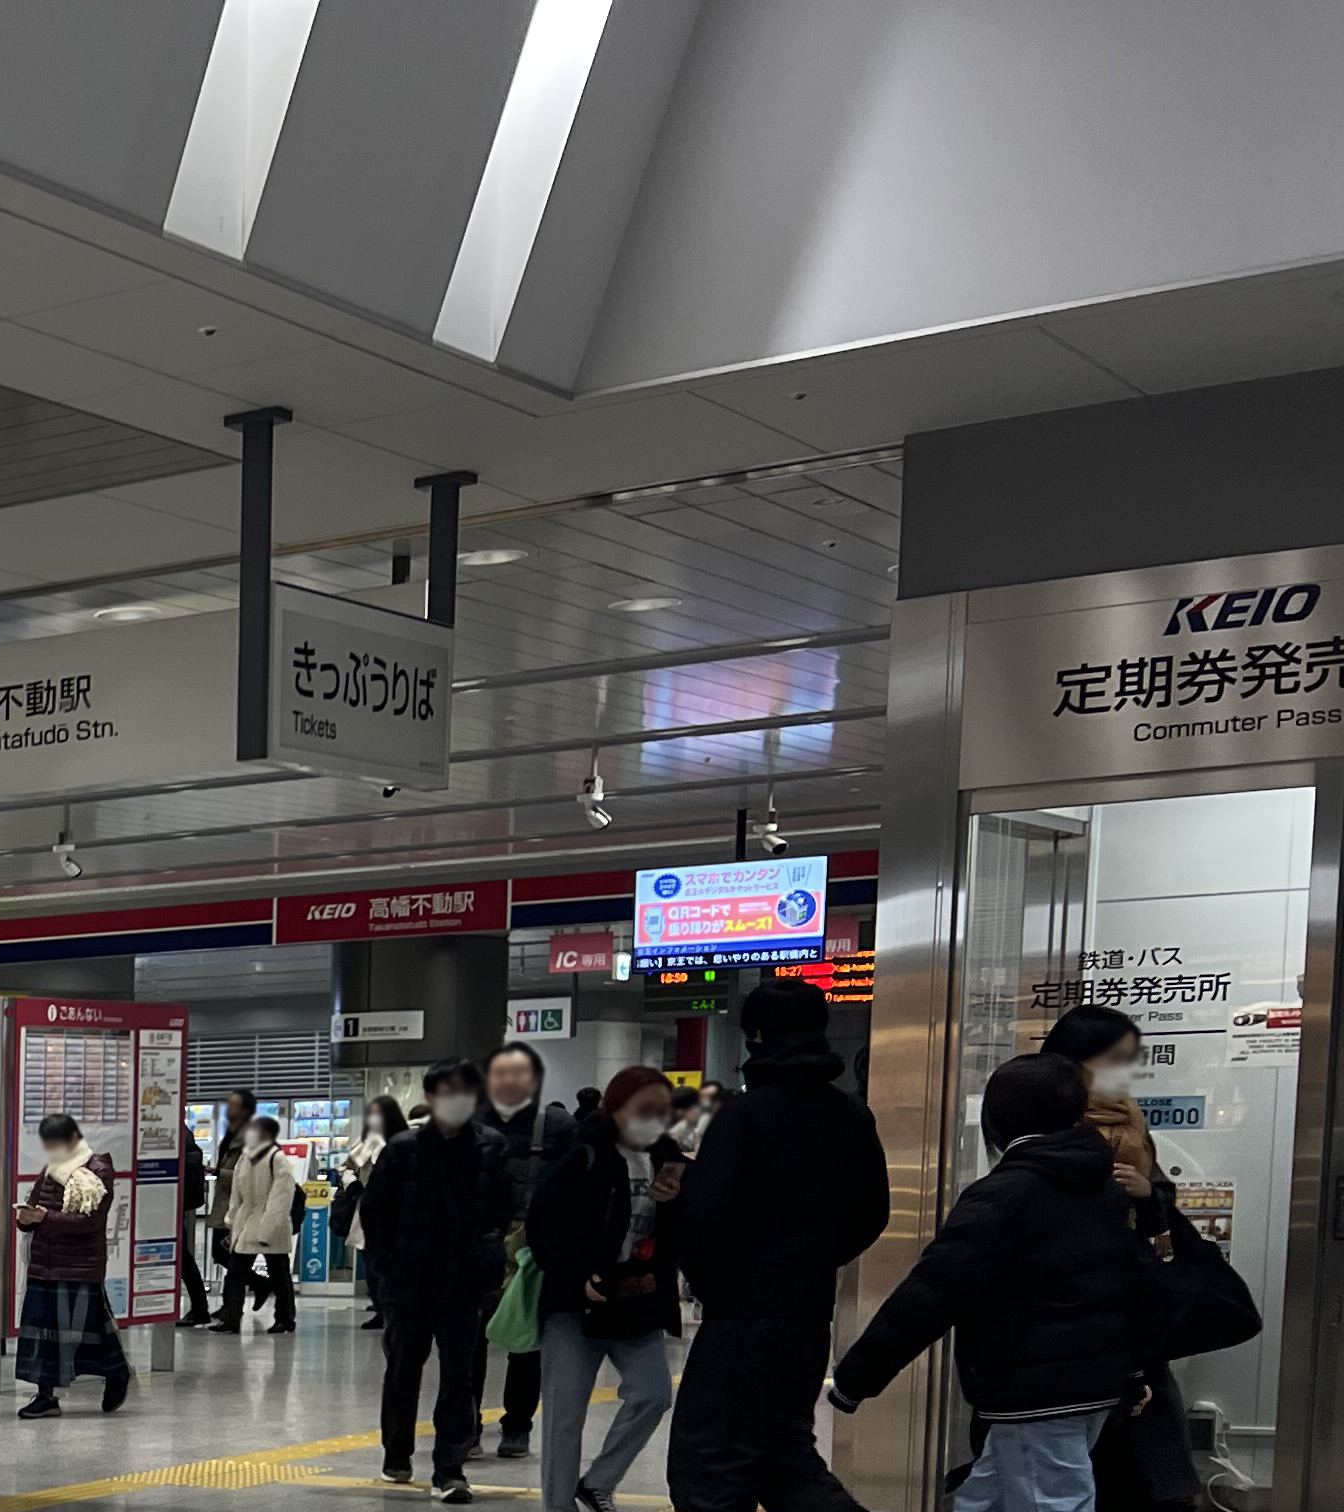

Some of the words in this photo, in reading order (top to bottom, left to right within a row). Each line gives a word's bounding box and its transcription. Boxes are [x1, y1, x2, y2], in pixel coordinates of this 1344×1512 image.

[1163, 584, 1322, 637] KEIO
[293, 641, 438, 721] きっぷうりば
[1053, 635, 1344, 718] 定期券発売
[75, 719, 120, 742] Stn.
[292, 710, 338, 740] Tickets
[1133, 714, 1269, 742] Commuter
[1276, 706, 1343, 729] Pass
[306, 903, 358, 921] KEIO
[369, 891, 475, 919] 高幡不動駅
[556, 951, 578, 969] IC
[1077, 947, 1183, 971] 鉄道・バス
[1030, 972, 1232, 1010] 定期券発売所
[1148, 1010, 1184, 1022] Pass
